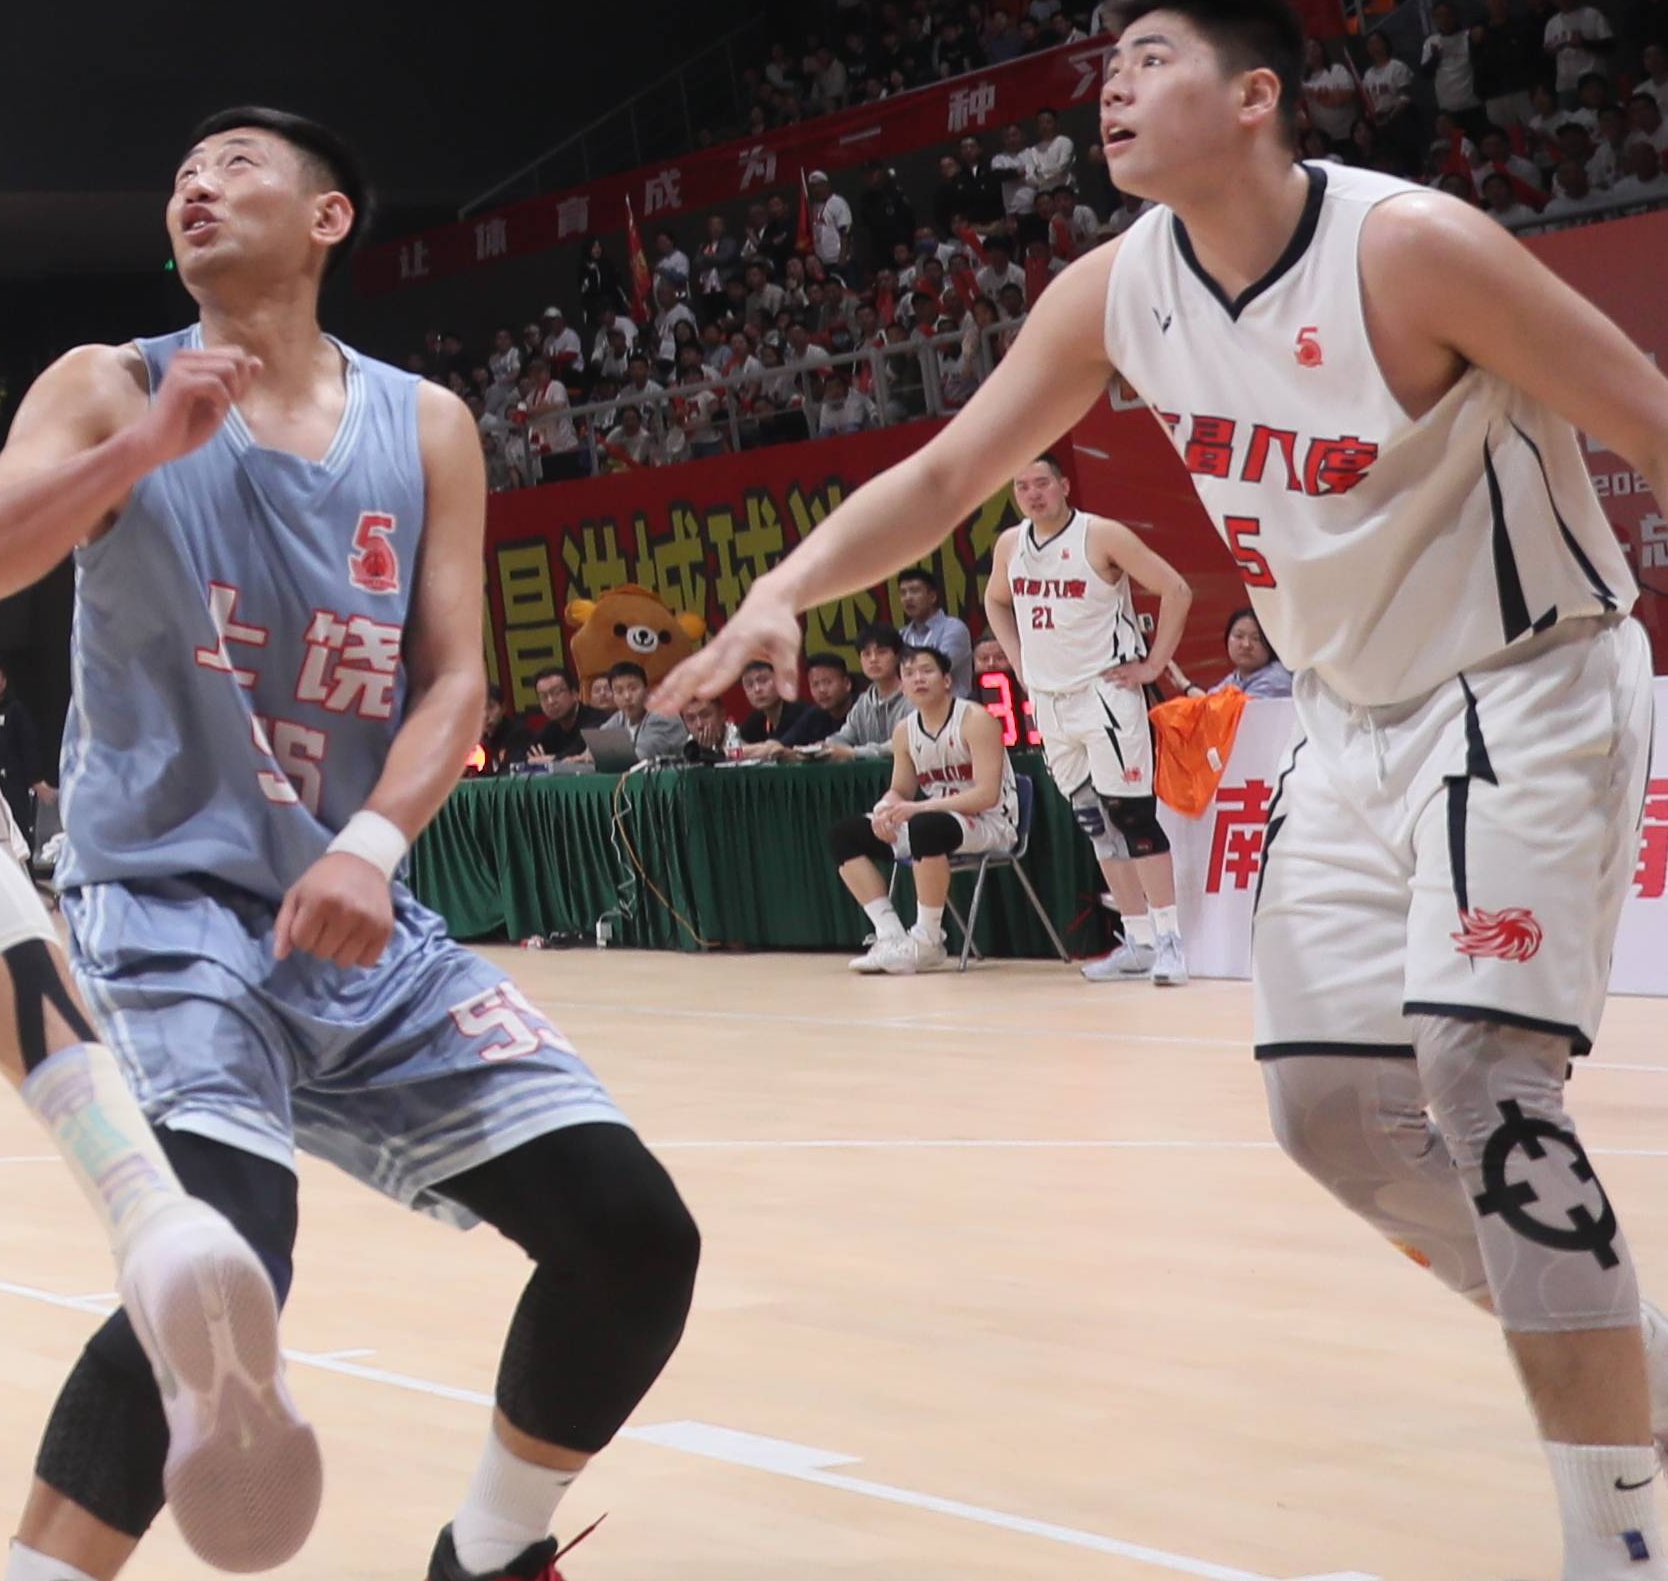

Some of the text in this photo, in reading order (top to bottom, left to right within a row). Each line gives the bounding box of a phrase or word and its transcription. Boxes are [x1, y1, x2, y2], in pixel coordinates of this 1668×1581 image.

[1151, 403, 1380, 497] 昌几度
[1223, 514, 1277, 588] 5
[195, 581, 405, 719] 上饶
[1031, 606, 1055, 630] 21
